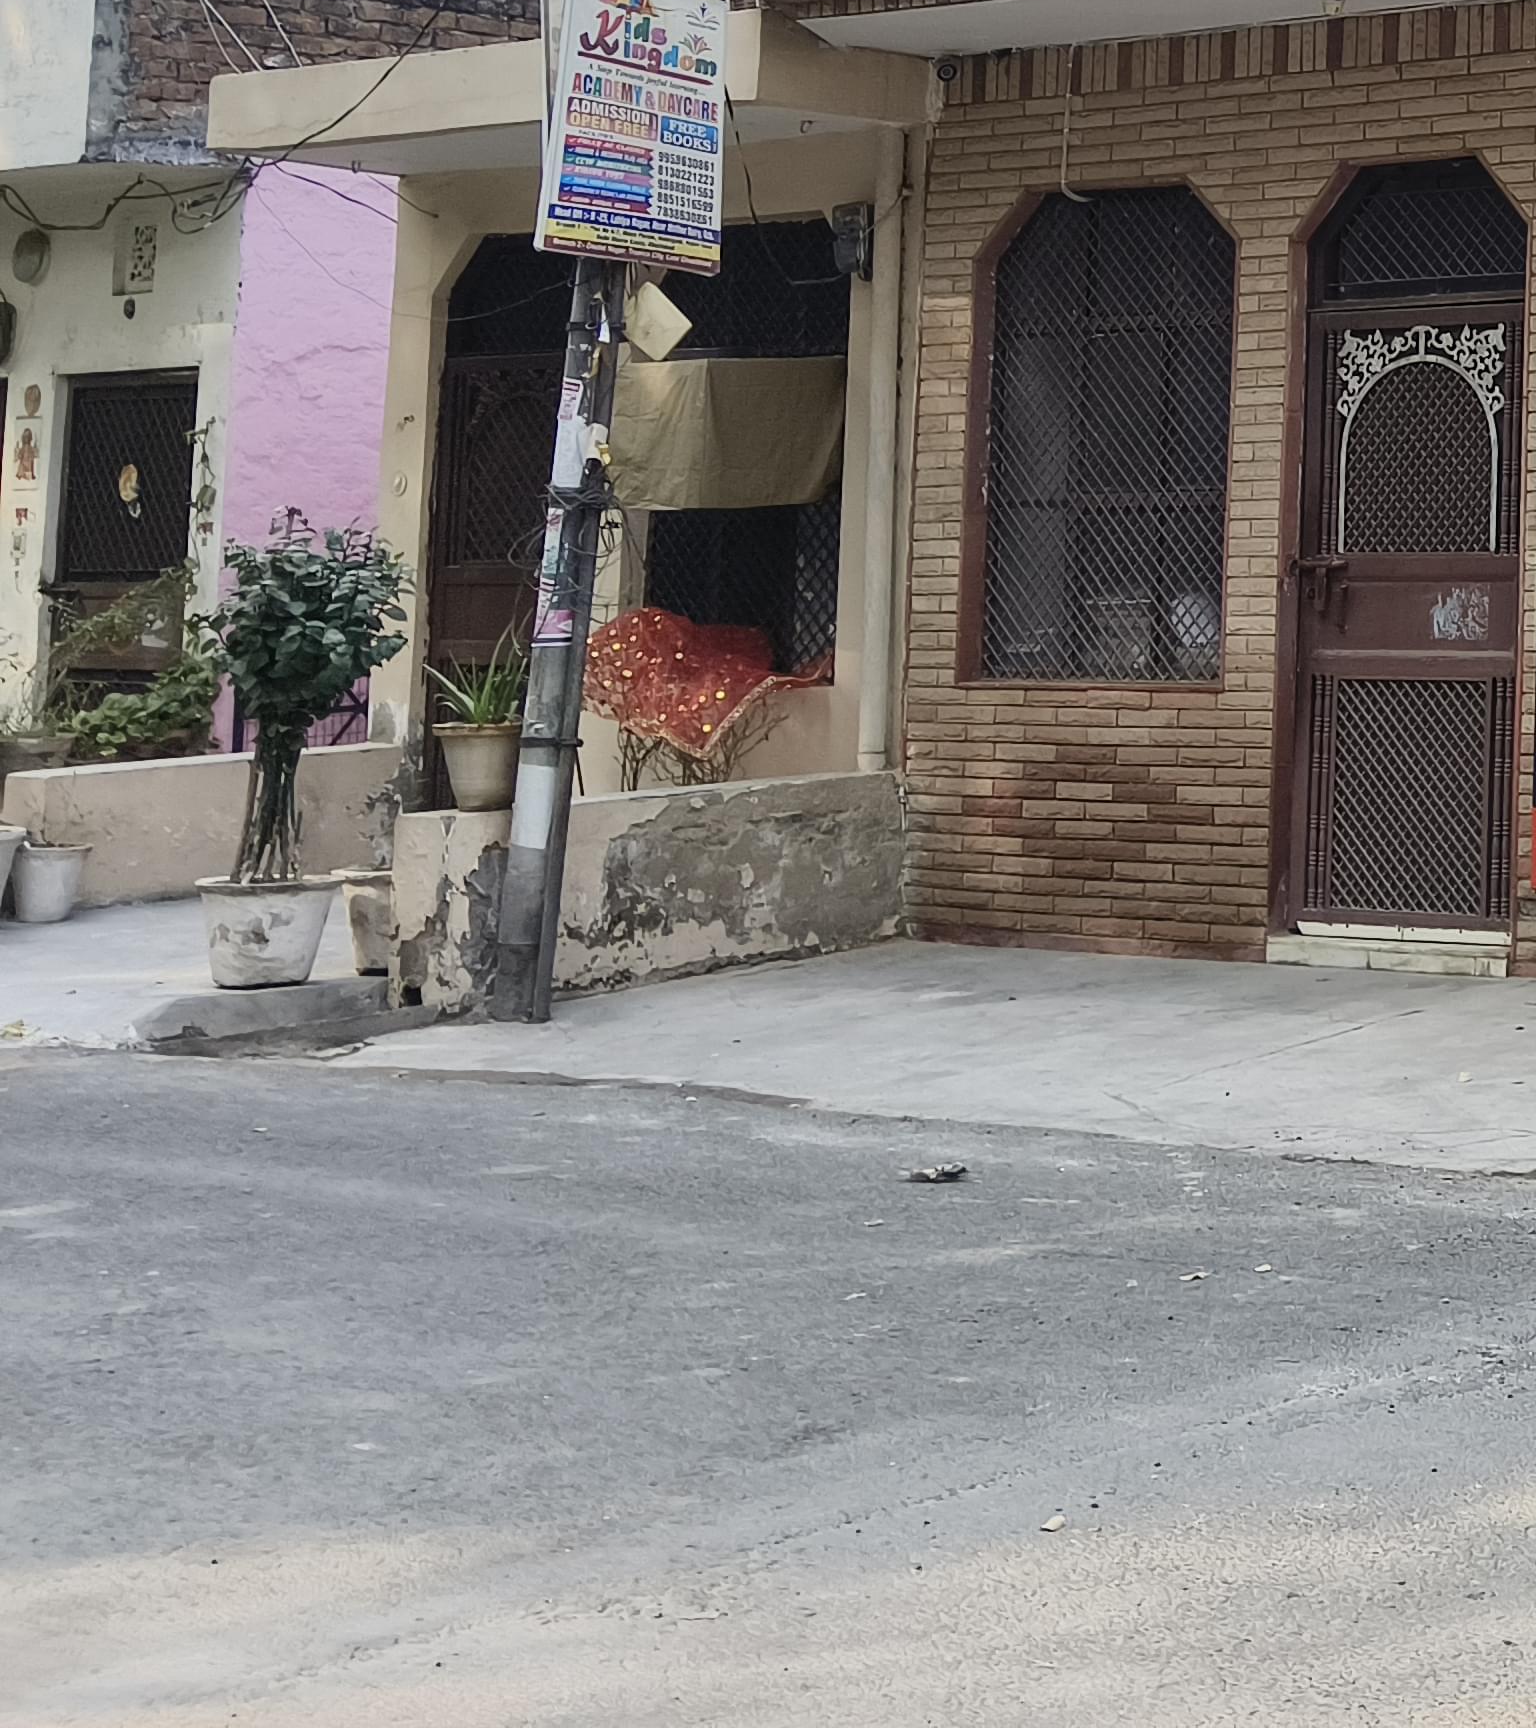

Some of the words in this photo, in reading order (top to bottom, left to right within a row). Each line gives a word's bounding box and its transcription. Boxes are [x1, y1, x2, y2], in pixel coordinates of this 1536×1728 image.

[580, 10, 667, 55] Kids
[572, 73, 642, 106] ACADEMY
[645, 92, 656, 110] &
[658, 89, 719, 122] DAYCARE
[570, 99, 649, 125] ADMISSION
[570, 112, 613, 131] OPEN
[614, 118, 649, 138] FREE
[669, 119, 707, 137] FREE
